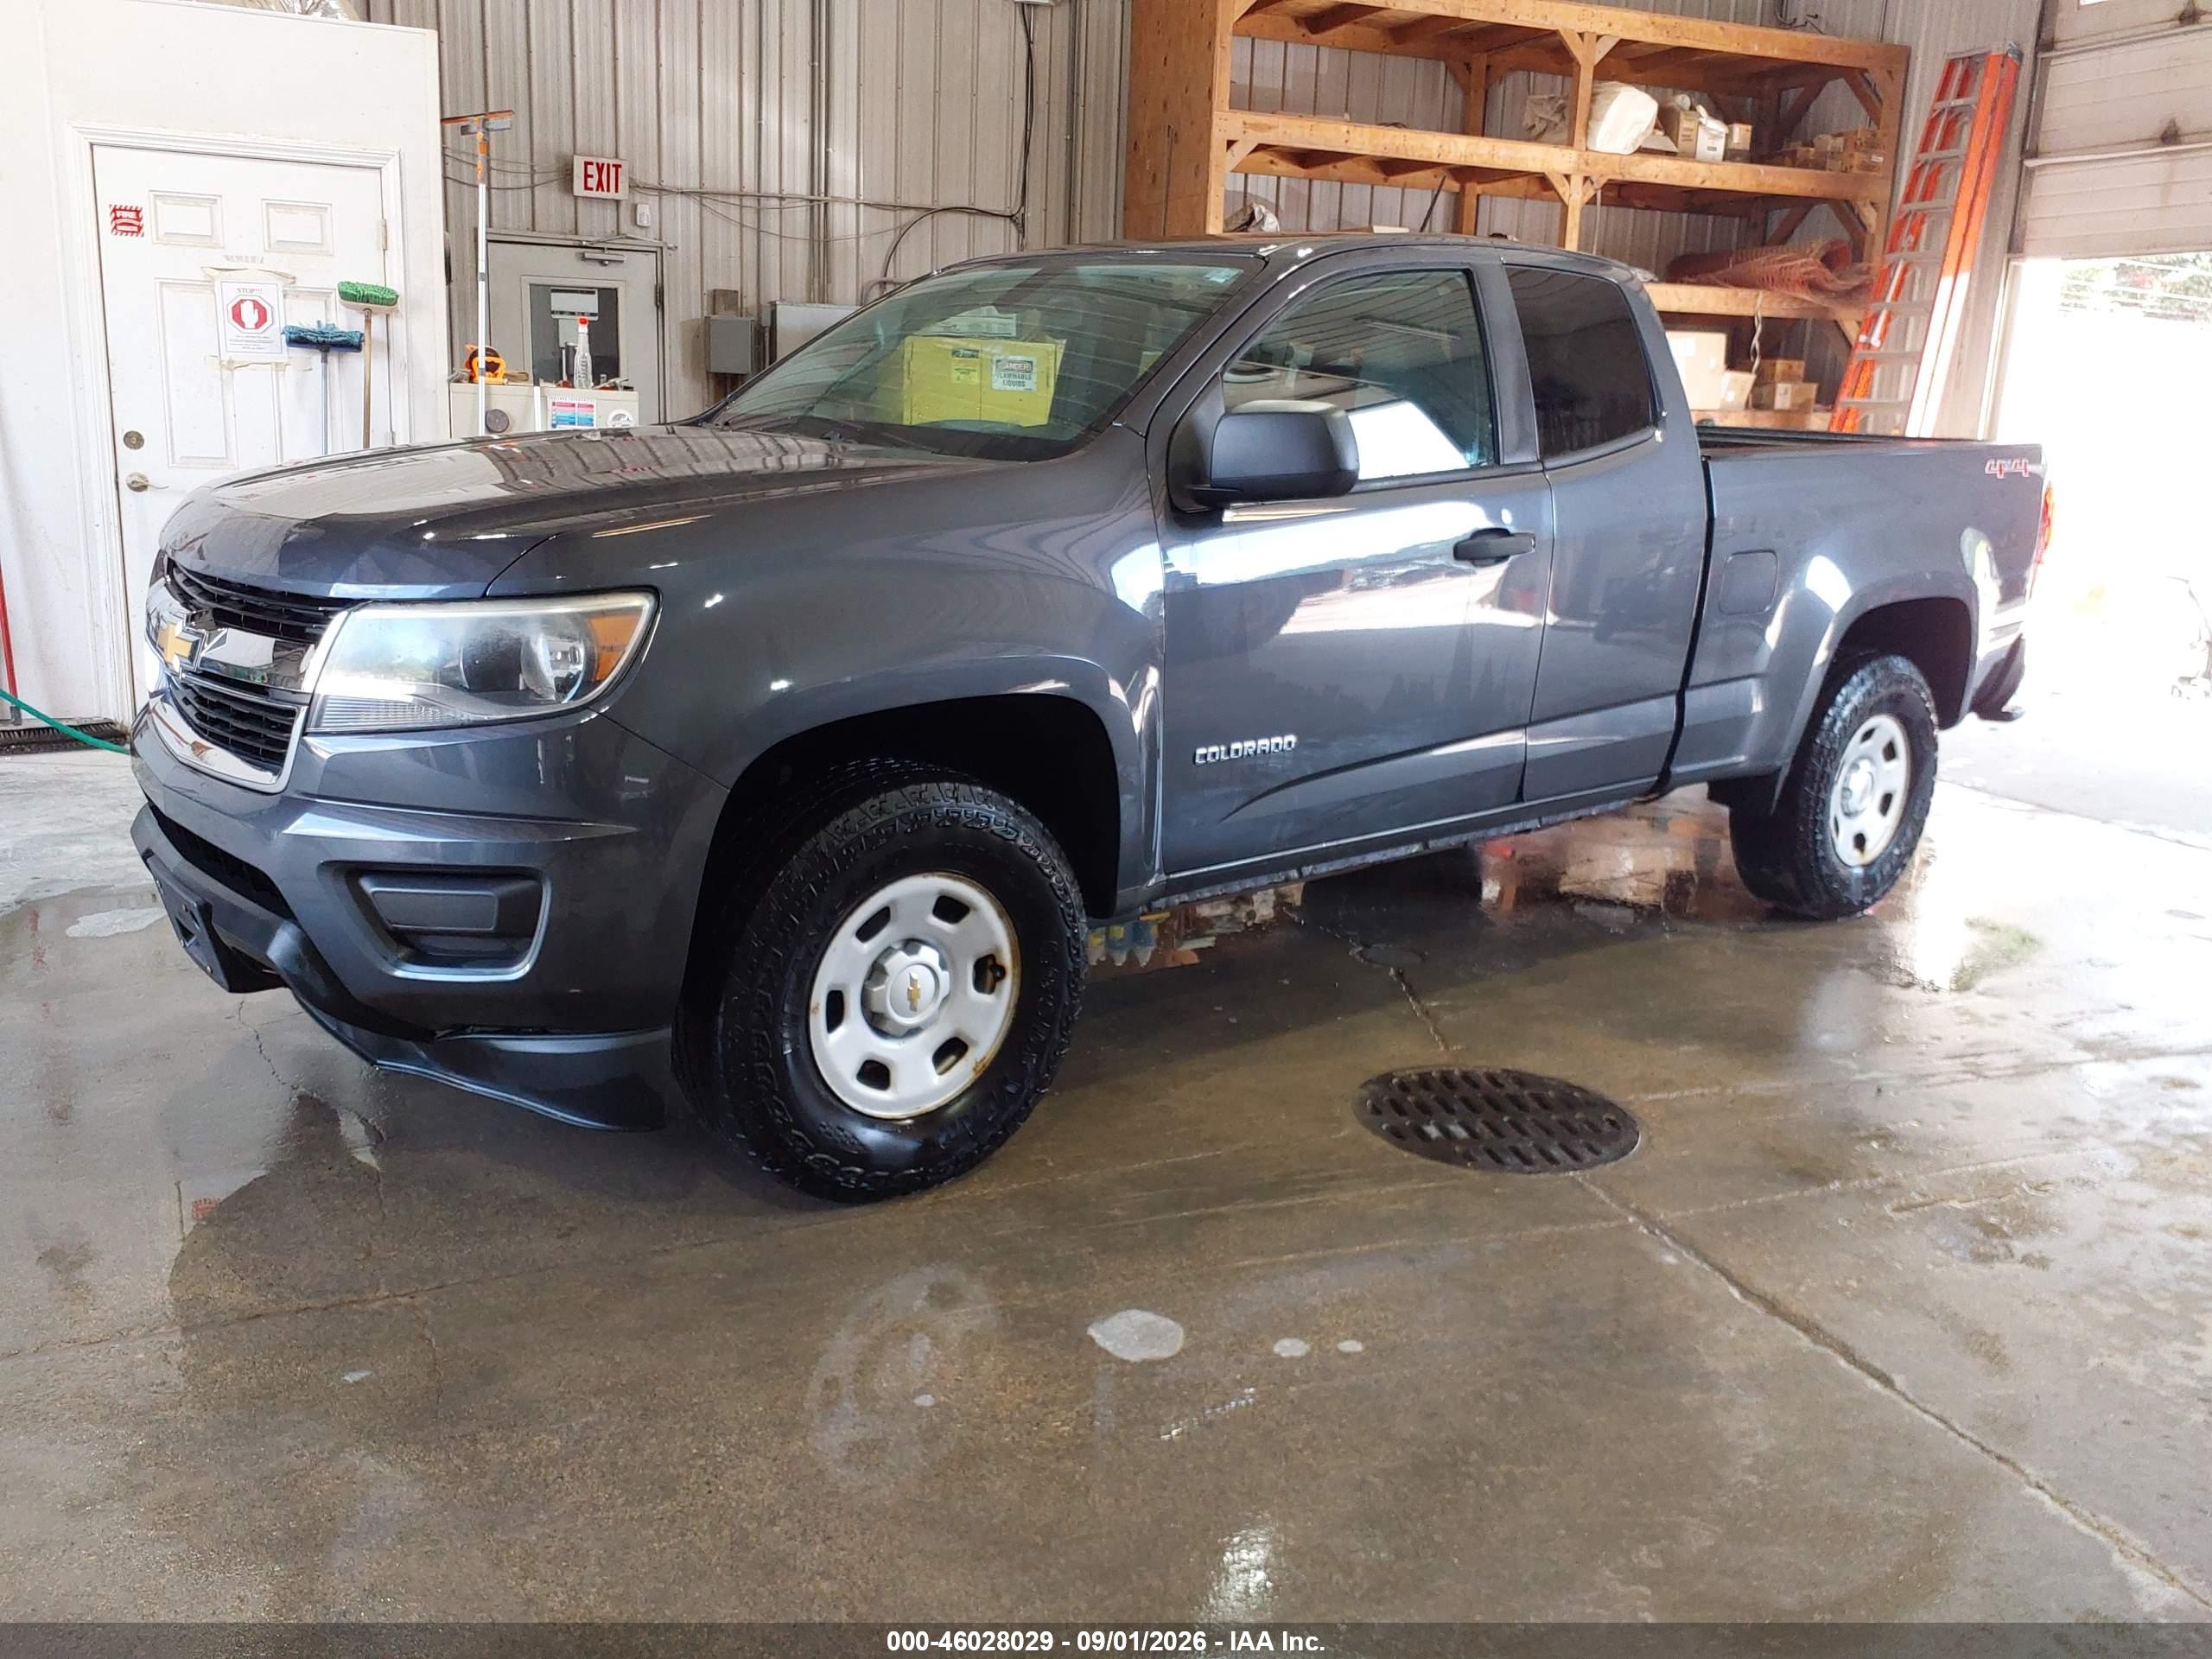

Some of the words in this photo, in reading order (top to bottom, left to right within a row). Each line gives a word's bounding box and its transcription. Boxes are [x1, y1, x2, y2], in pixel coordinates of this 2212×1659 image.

[583, 161, 622, 194] EXIT
[116, 211, 137, 219] FIRE
[998, 362, 1030, 371] ANGER
[1002, 379, 1026, 388] LIQUIDS
[1194, 734, 1297, 765] COLORADO
